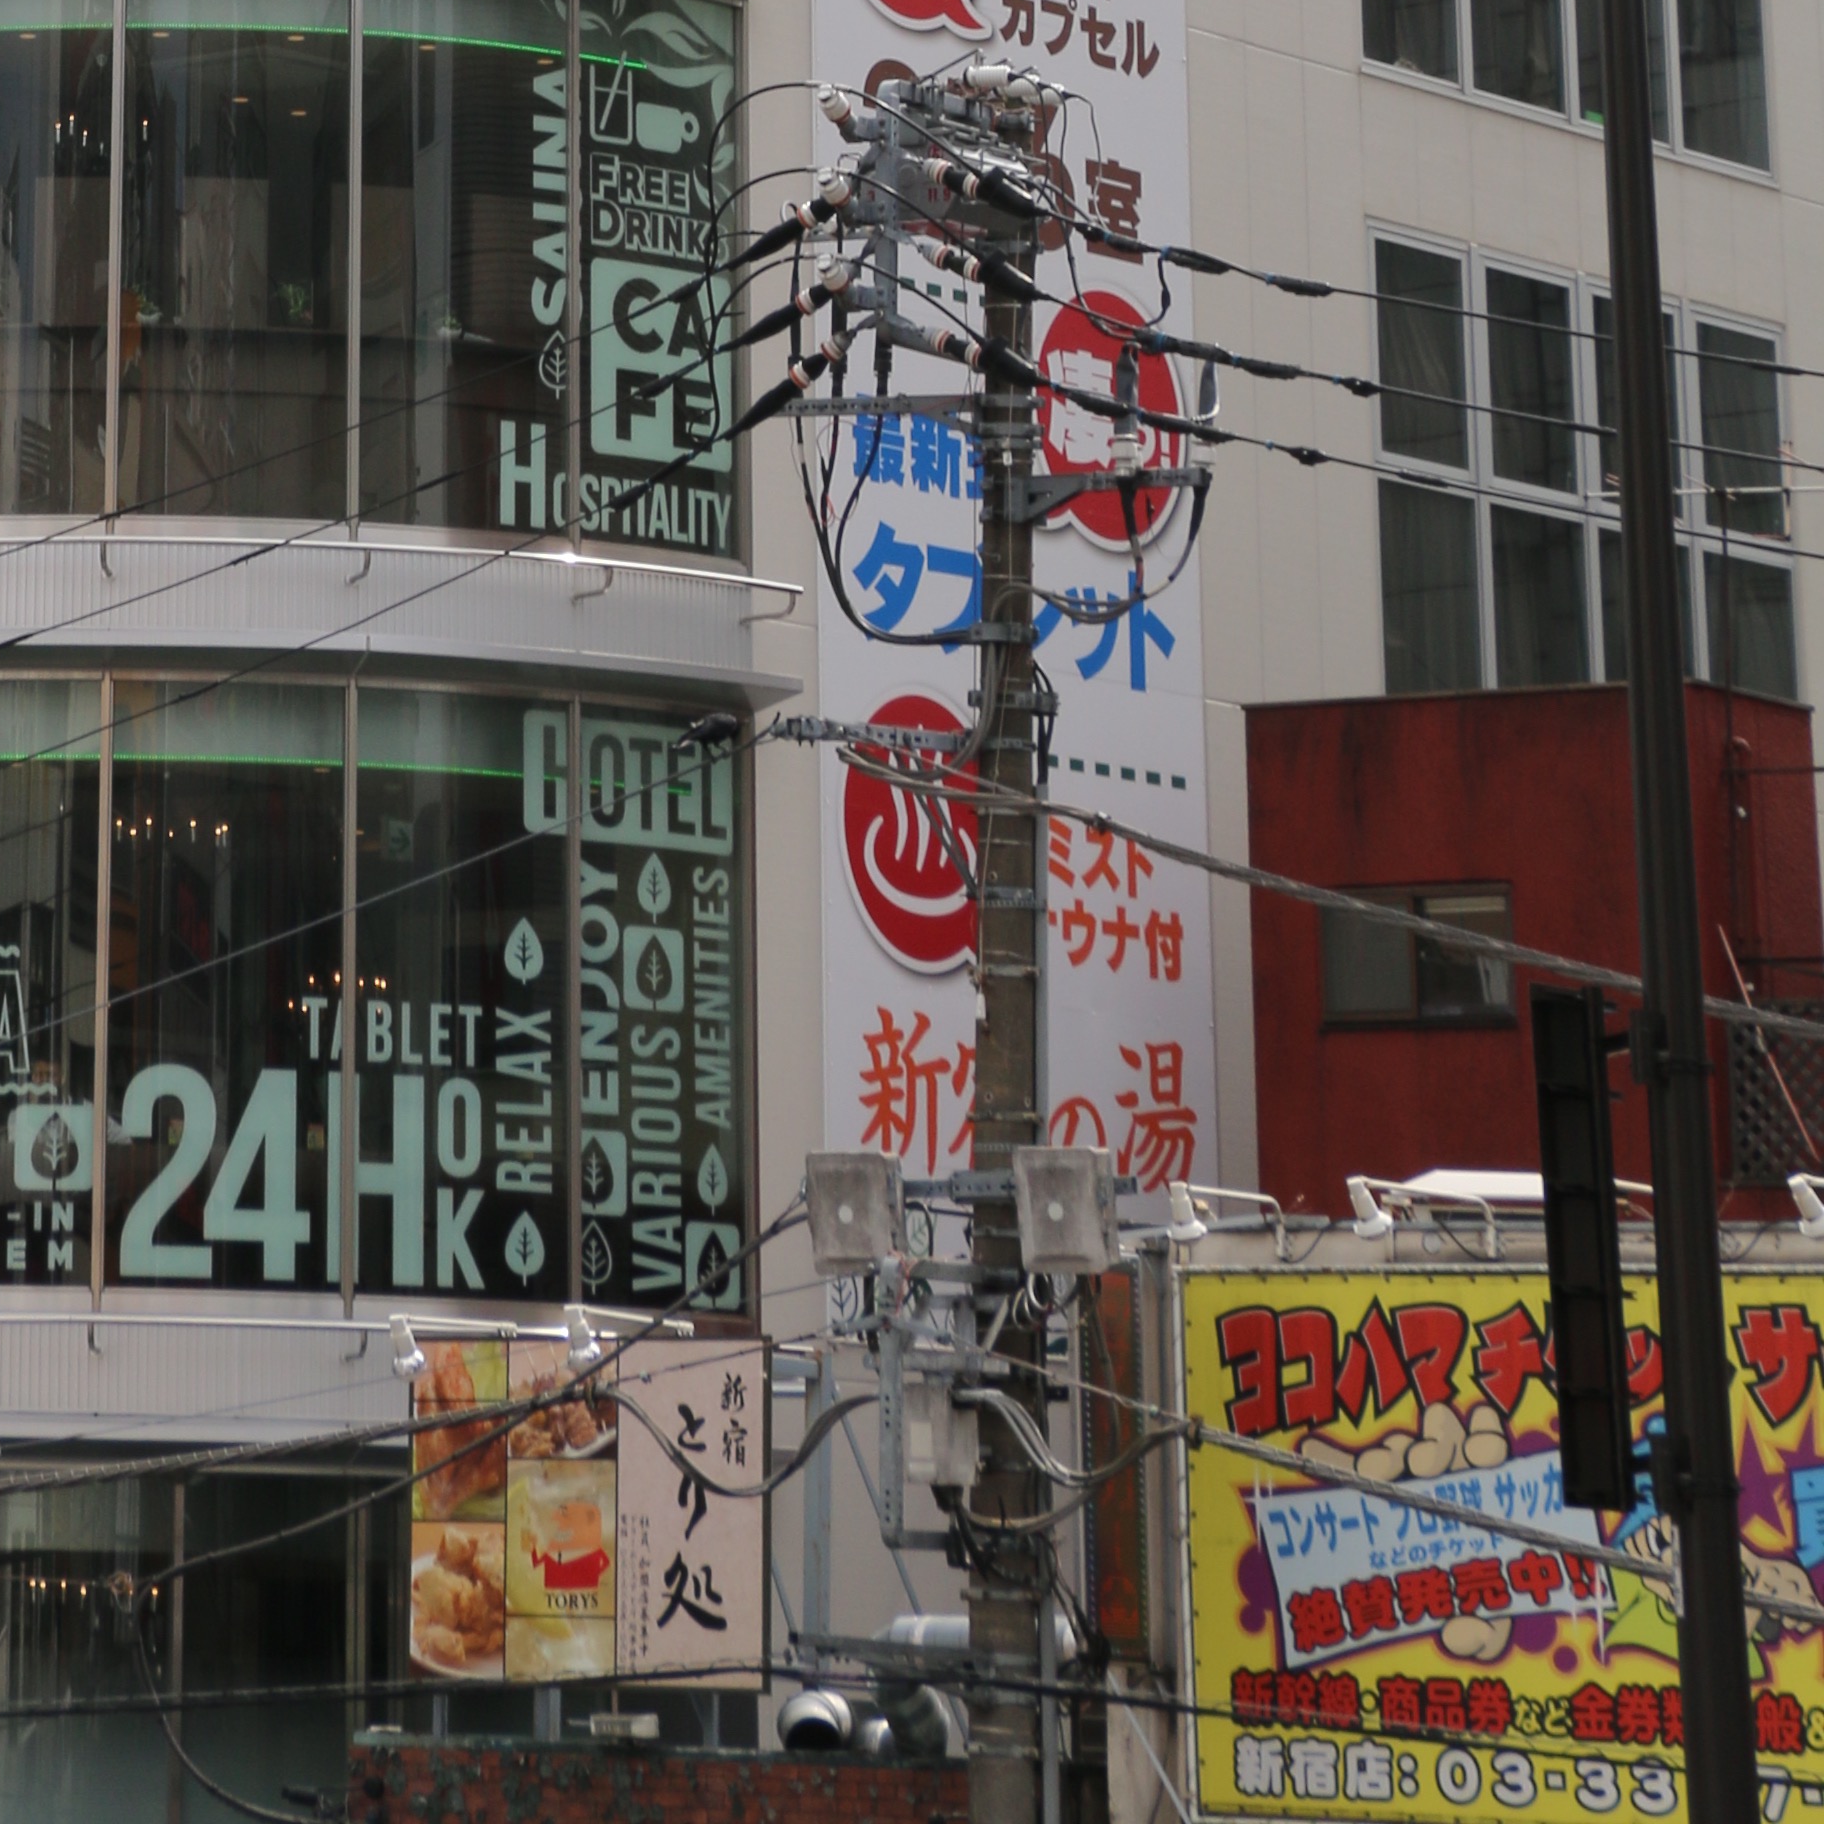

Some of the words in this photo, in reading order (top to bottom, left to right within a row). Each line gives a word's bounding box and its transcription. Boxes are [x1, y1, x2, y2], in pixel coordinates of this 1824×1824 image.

[531, 67, 570, 327] SAUNA
[589, 151, 691, 216] FREE
[499, 418, 733, 551] HOSPITALITY
[1047, 815, 1155, 900] ミスト
[579, 856, 621, 1117] ENJOY
[692, 865, 732, 1130] AMENITIES
[1047, 897, 1185, 983] ウナ付
[300, 995, 483, 1068] TABLET
[495, 1007, 553, 1194] RELAX
[630, 1026, 683, 1293] VARIOUS
[719, 1371, 749, 1469] 新宿
[655, 1403, 729, 1631] とり処
[1267, 1495, 1381, 1559] コンサート
[545, 1592, 600, 1611] TORYS
